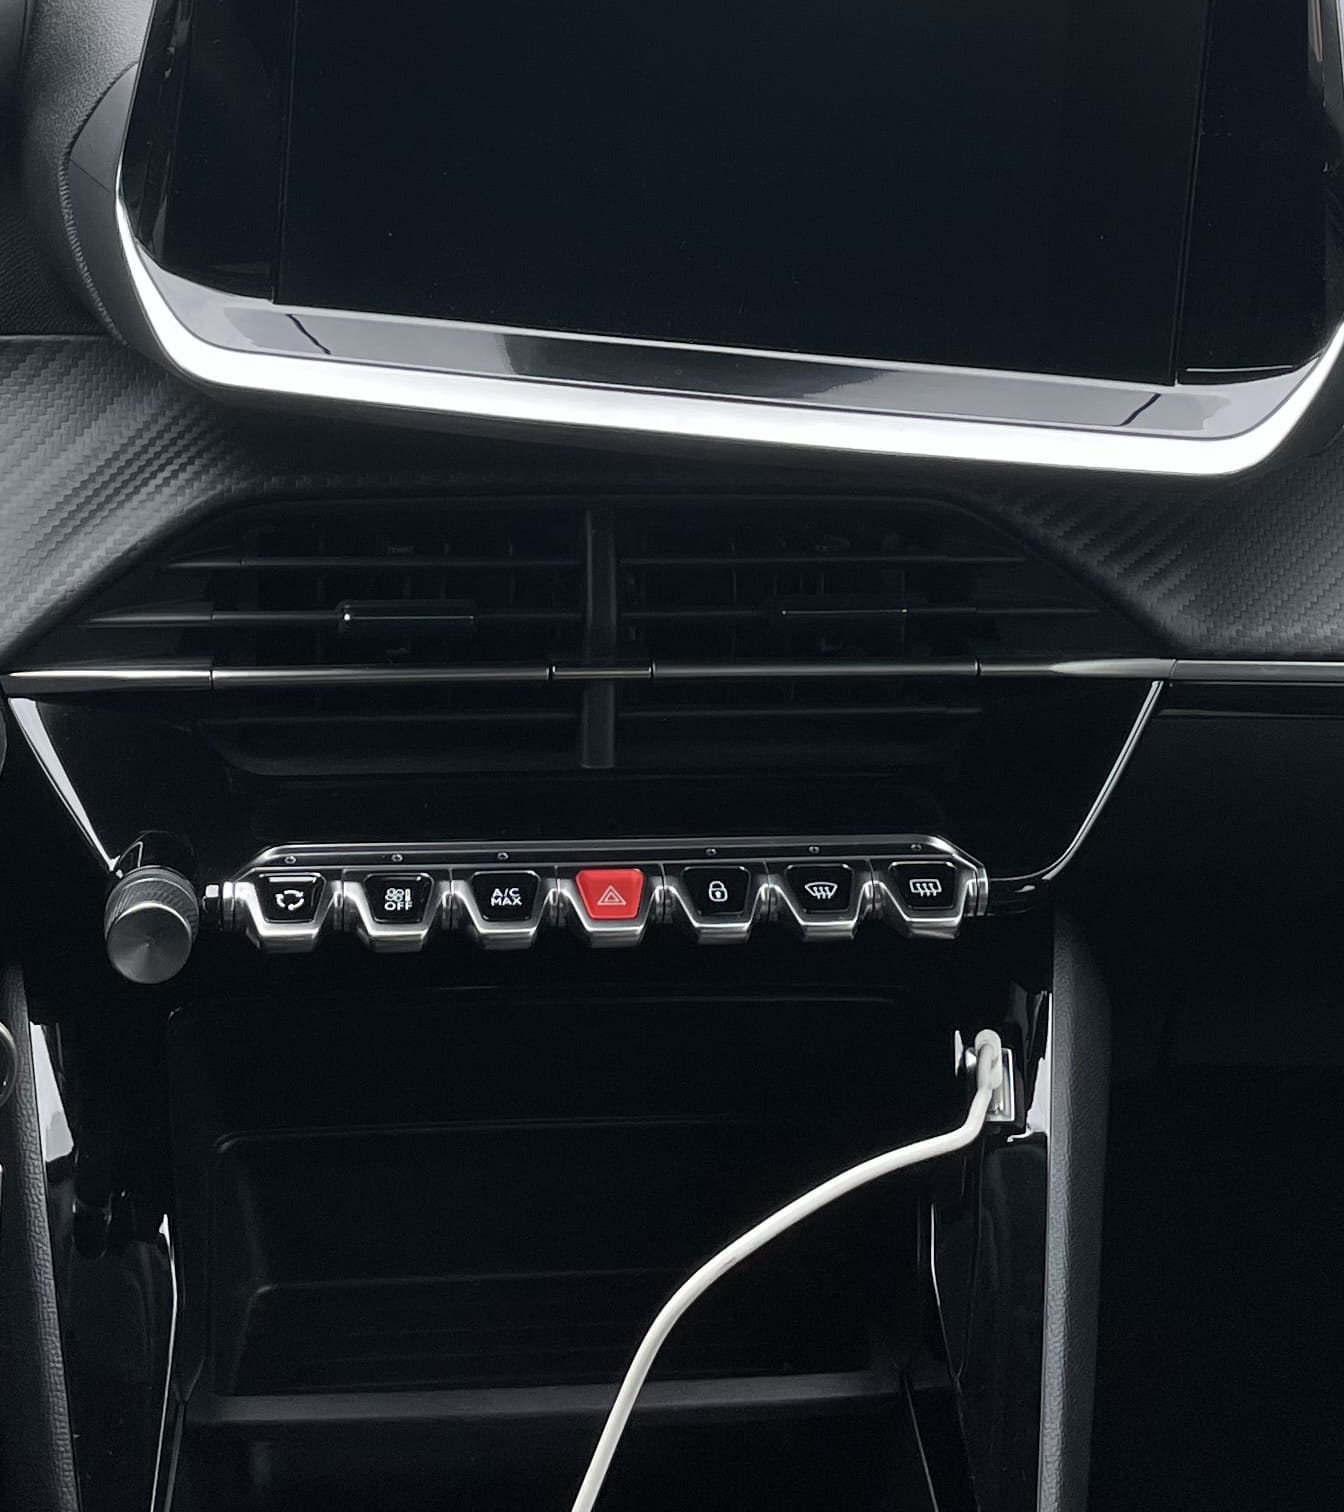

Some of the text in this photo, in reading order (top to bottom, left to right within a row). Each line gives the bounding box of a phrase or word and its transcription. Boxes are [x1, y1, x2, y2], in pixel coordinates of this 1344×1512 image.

[492, 888, 520, 897] A/C
[384, 901, 413, 911] OFF
[490, 896, 522, 907] MAX
